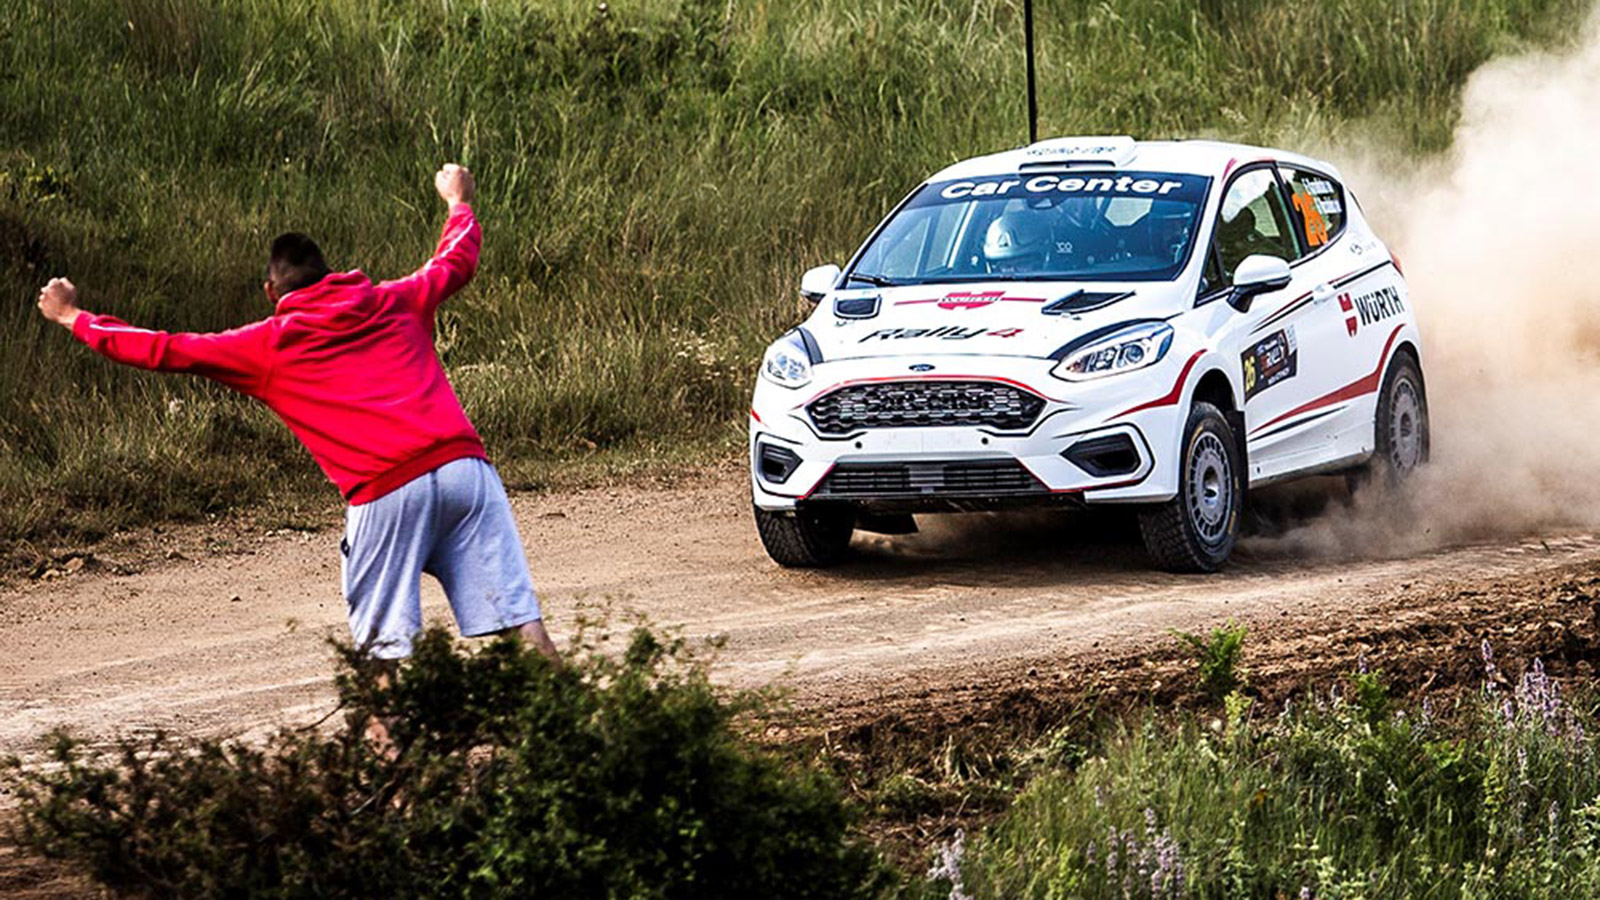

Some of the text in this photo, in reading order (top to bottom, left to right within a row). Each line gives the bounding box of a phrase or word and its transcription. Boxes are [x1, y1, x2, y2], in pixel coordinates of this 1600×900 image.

[941, 175, 1182, 199] Car Center
[1354, 286, 1405, 326] WÜRTH
[857, 325, 1025, 343] Rally 4
